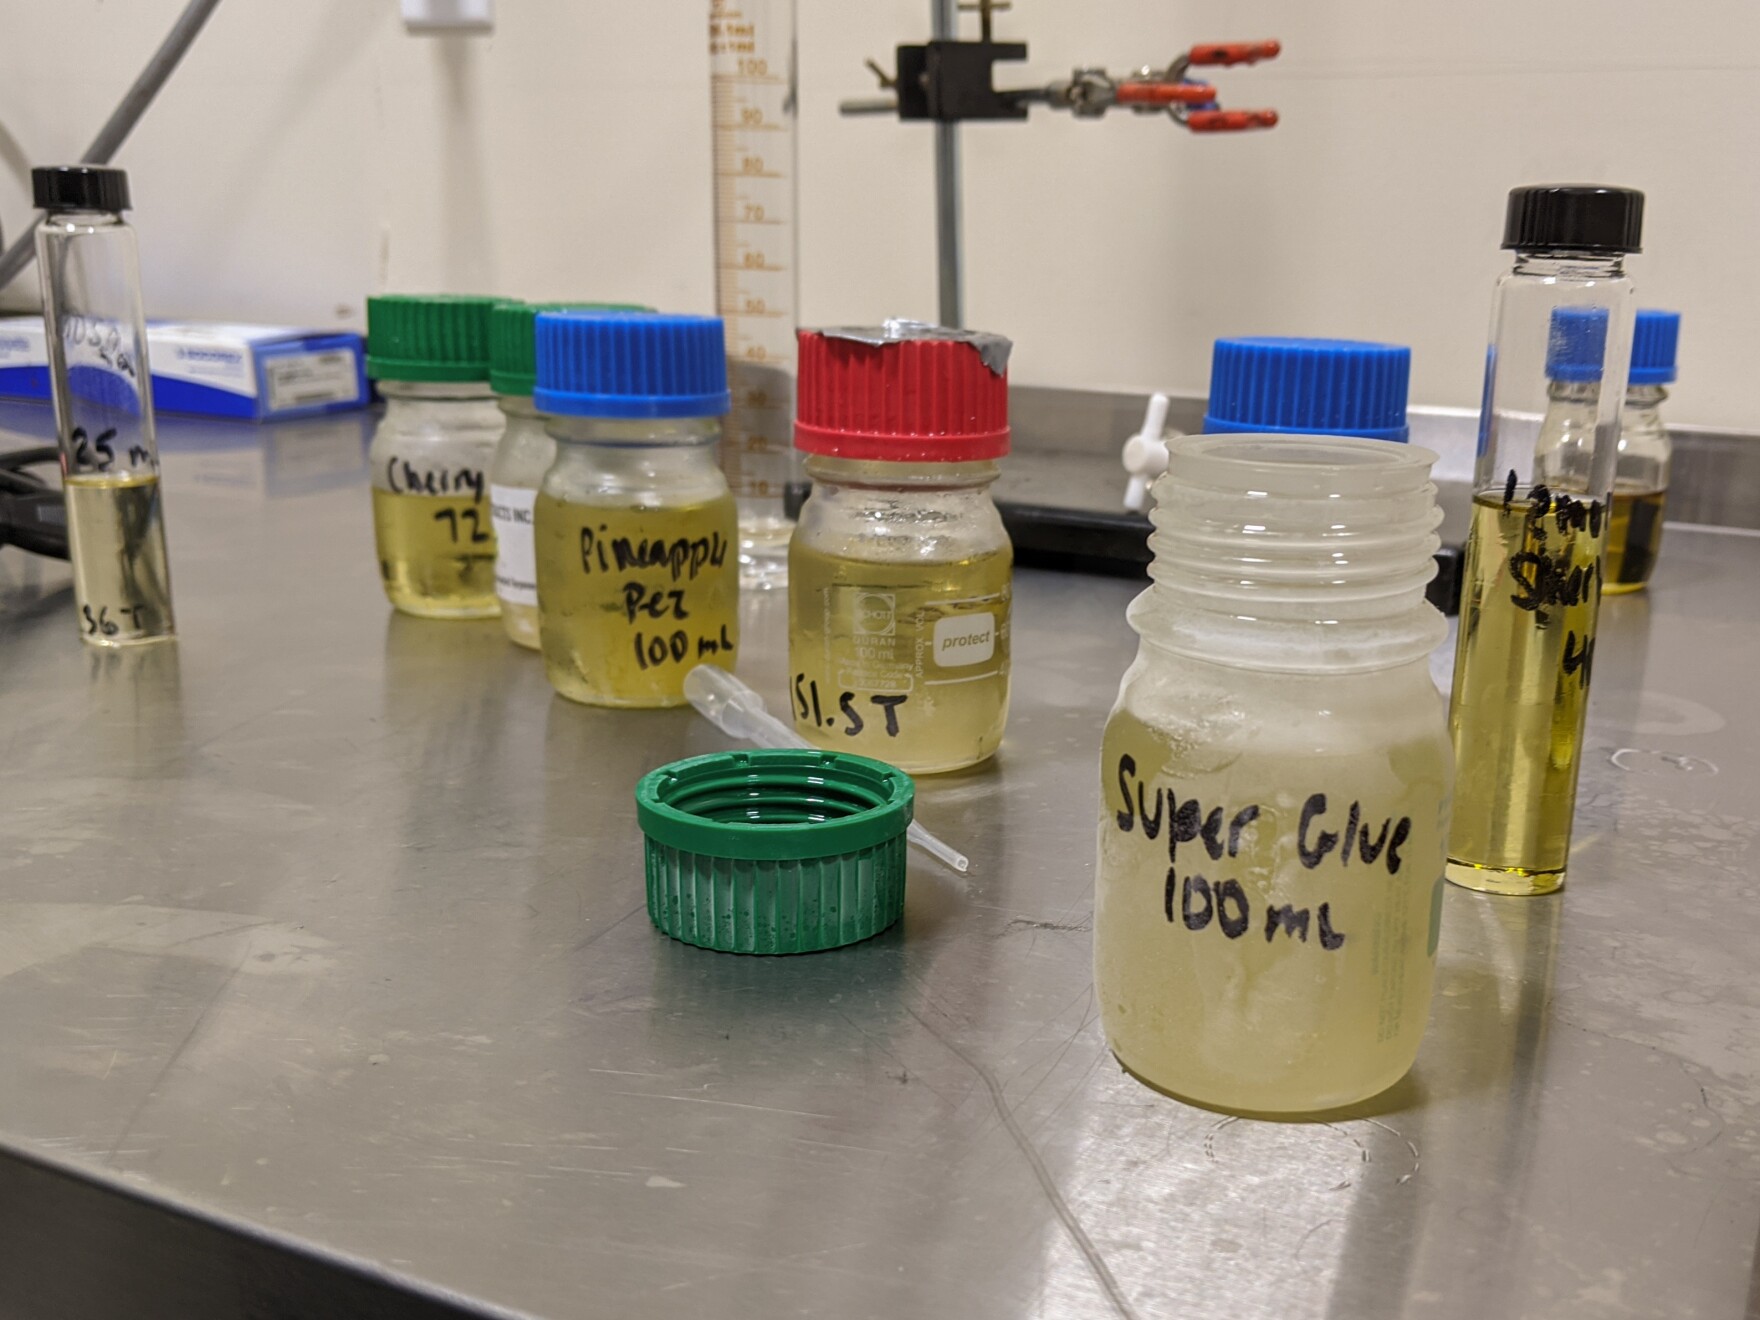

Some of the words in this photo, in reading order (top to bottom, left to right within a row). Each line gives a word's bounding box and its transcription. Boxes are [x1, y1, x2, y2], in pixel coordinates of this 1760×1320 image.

[737, 58, 768, 77] 100
[743, 205, 765, 222] 70
[72, 427, 118, 473] 25
[387, 456, 484, 504] Cherry
[434, 508, 490, 542] 72
[634, 629, 689, 671] 100
[853, 635, 896, 647] DURAN
[915, 637, 925, 679] APPROX
[942, 630, 991, 651] protect
[870, 694, 908, 738] T
[1115, 752, 1261, 863] Super
[1297, 792, 1412, 875] Glue
[1164, 865, 1250, 939] 100
